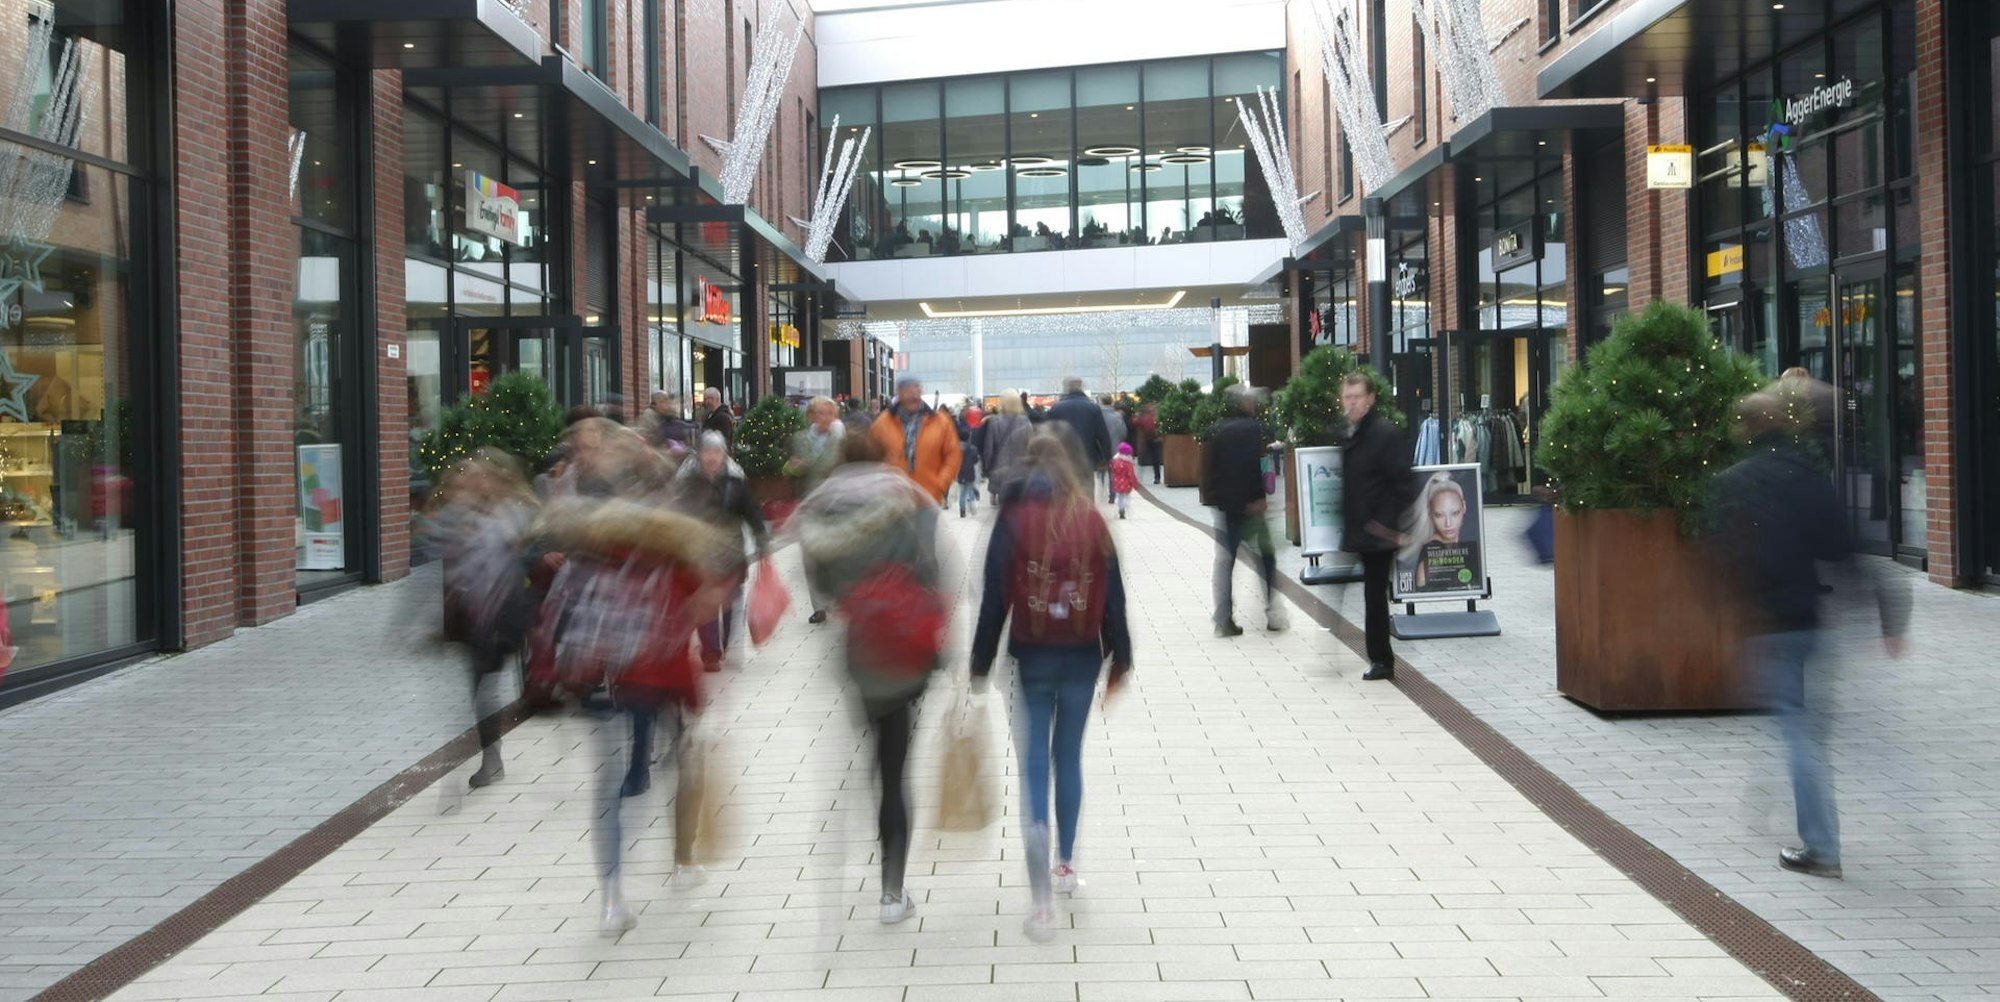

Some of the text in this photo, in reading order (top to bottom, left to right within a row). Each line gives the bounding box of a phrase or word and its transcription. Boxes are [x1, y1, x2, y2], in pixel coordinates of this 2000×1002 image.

[1785, 75, 1852, 125] AggerEnergie
[1498, 231, 1518, 256] BONITA
[1399, 578, 1413, 592] CUT
